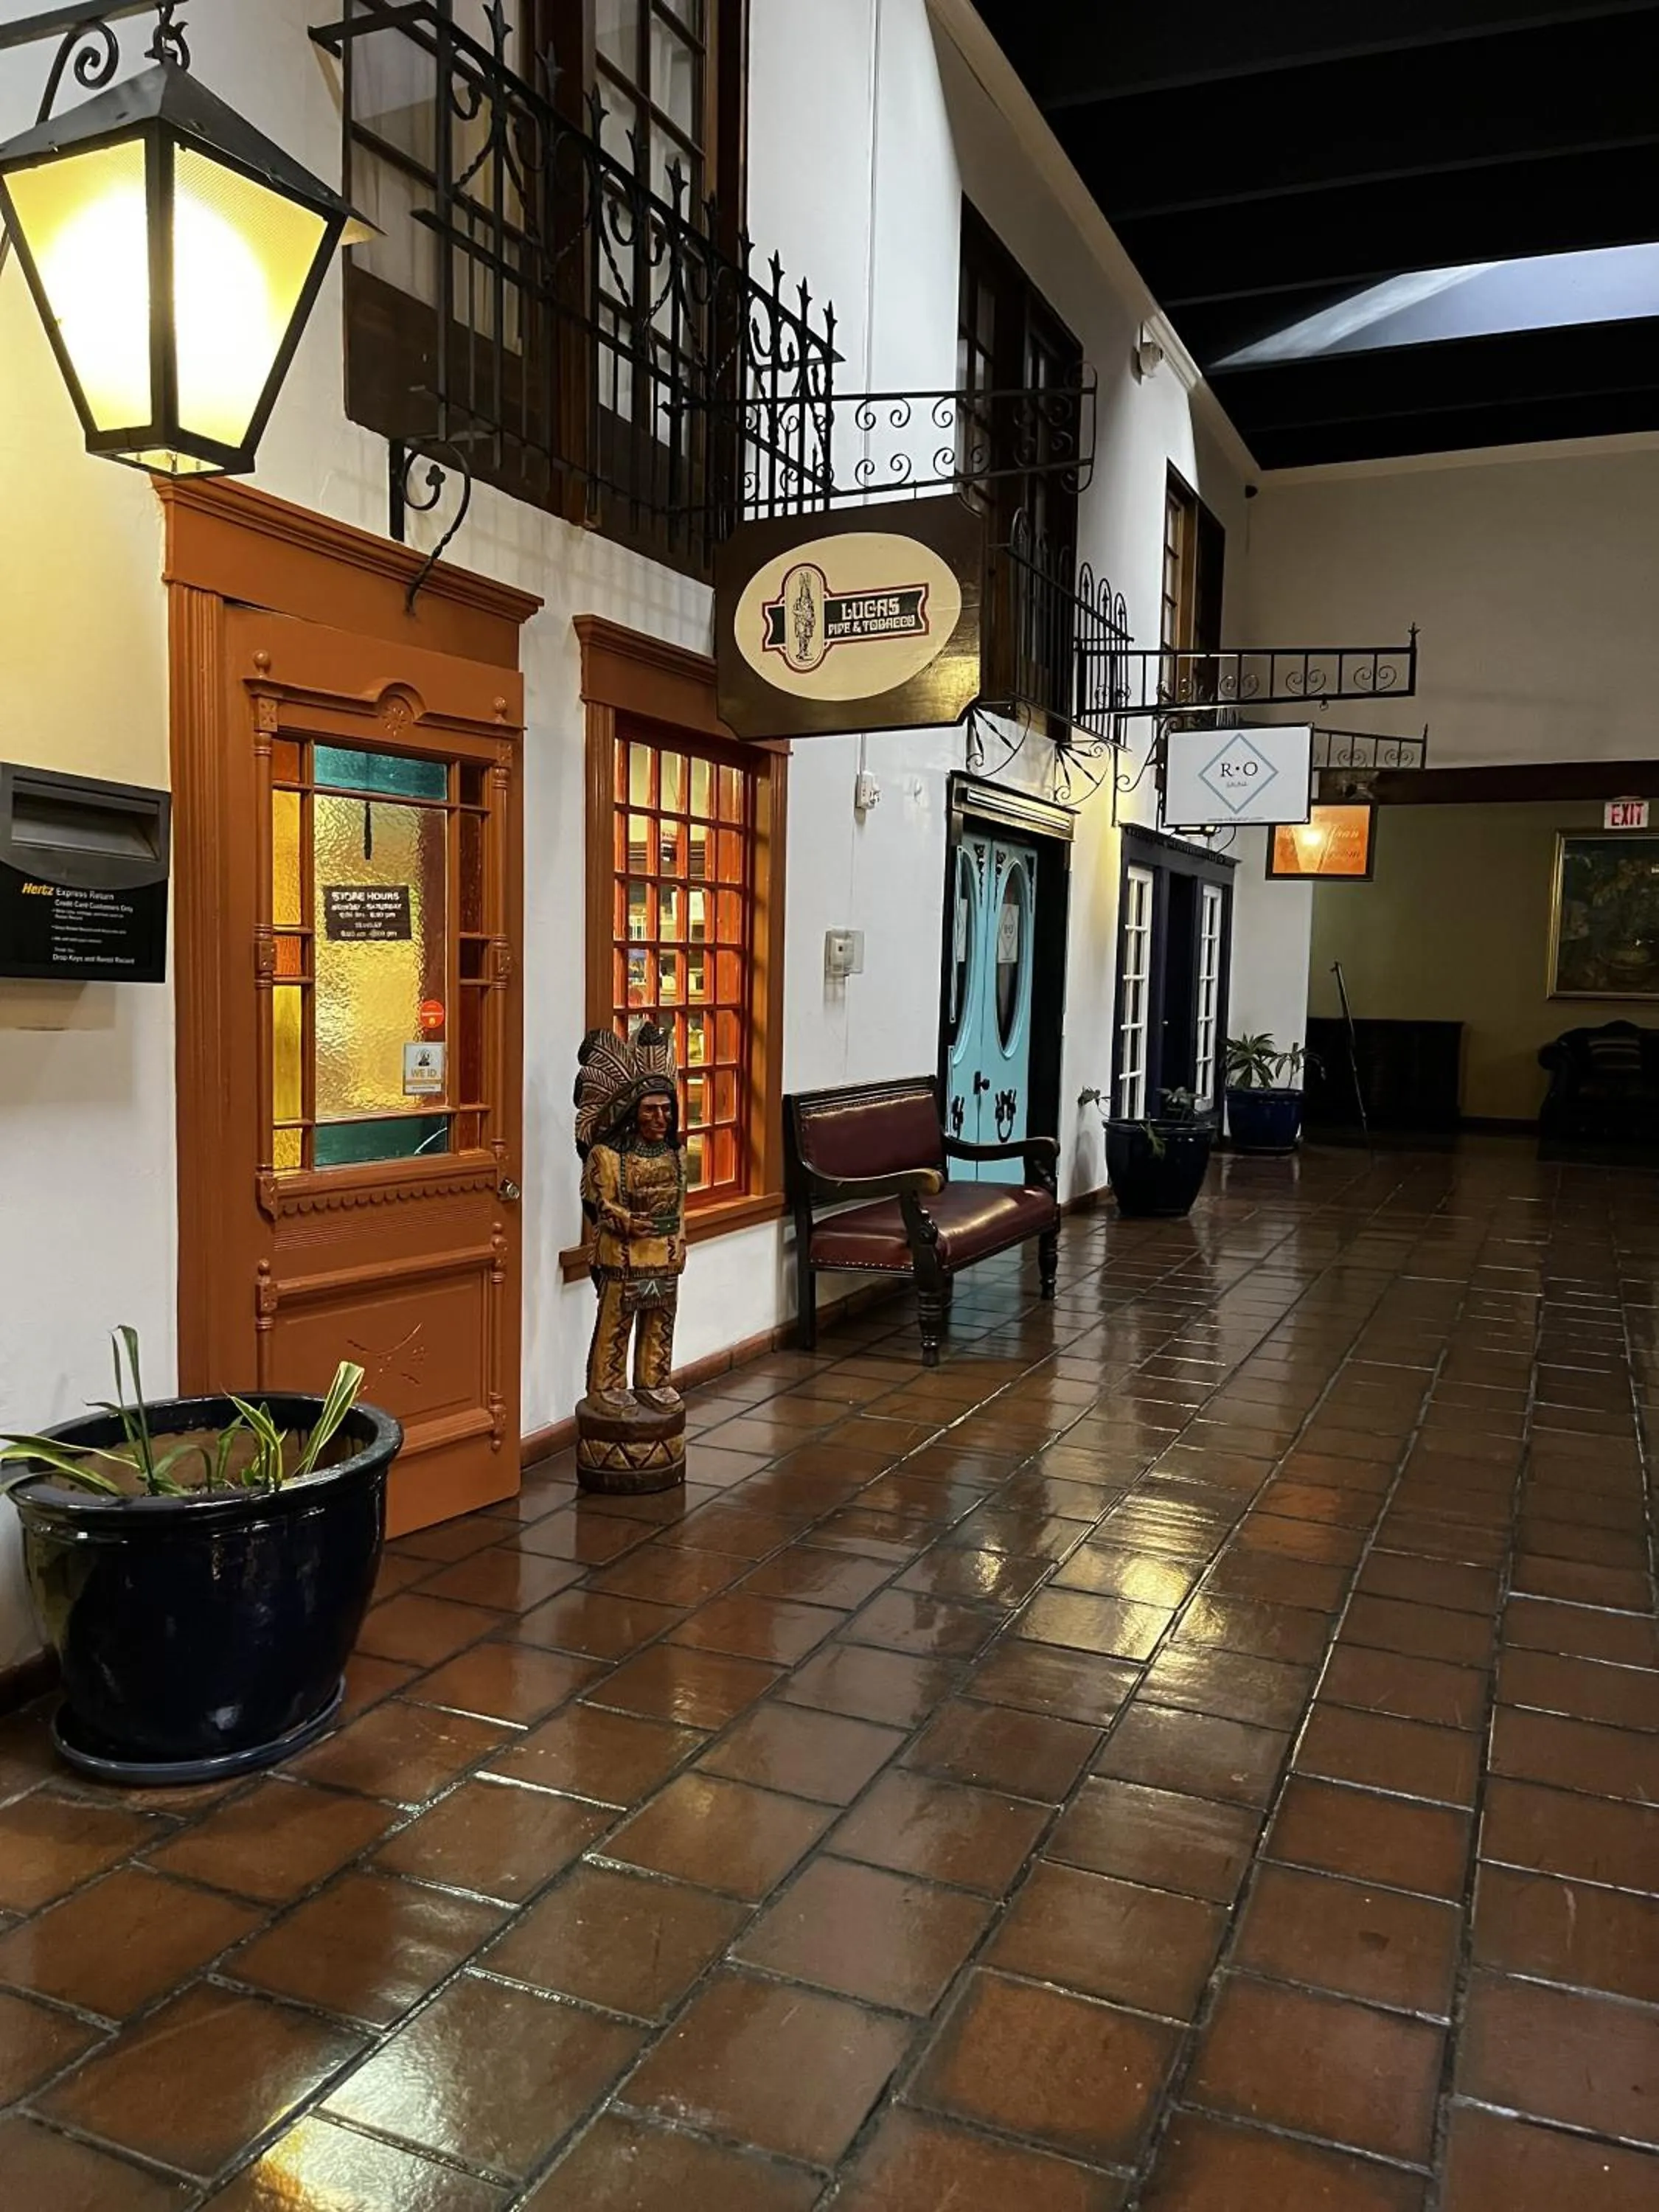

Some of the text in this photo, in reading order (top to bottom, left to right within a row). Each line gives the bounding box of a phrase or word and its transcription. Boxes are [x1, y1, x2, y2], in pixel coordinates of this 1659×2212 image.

[841, 598, 900, 620] LUCAS
[828, 615, 915, 636] PIPE & TOBACCO
[1610, 803, 1644, 826] EXIT
[21, 883, 114, 900] Hertz Express Return
[332, 891, 400, 901] STORE HOURS
[411, 1068, 437, 1078] WE ID
